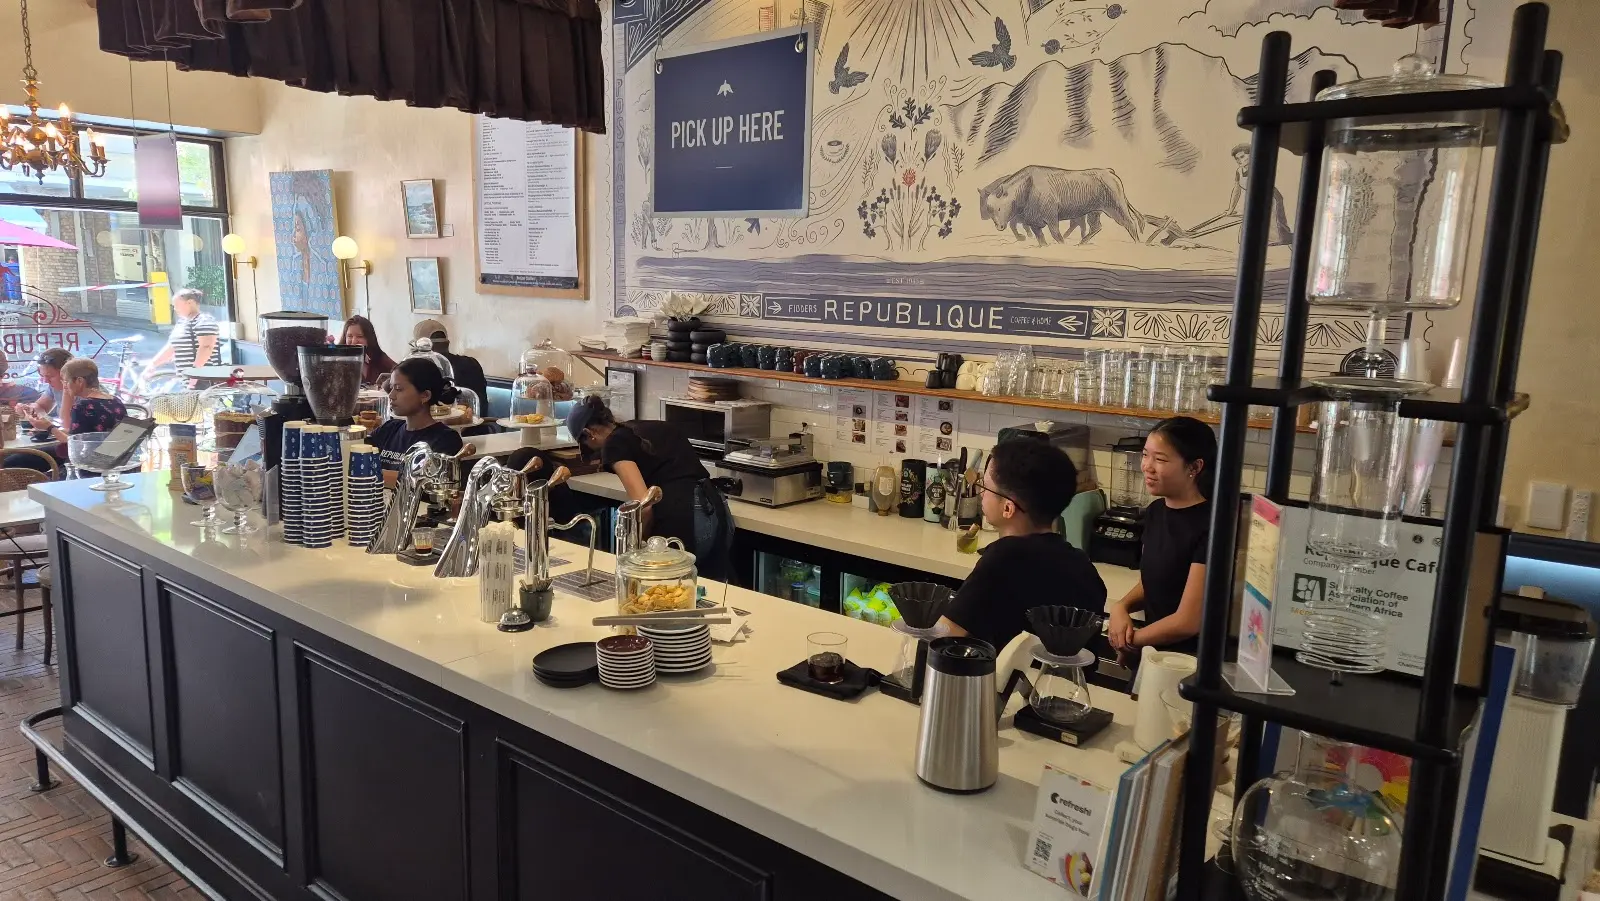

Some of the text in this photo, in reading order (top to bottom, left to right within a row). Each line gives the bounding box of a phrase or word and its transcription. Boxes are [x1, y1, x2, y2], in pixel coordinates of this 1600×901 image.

[671, 109, 785, 149] PICK UP HERE
[824, 299, 1004, 330] REPUBLIQUE
[1303, 557, 1340, 571] Company
[1376, 588, 1409, 602] Coffee
[1388, 600, 1399, 609] of
[1373, 606, 1404, 618] Africa
[1059, 796, 1093, 817] refreshi
